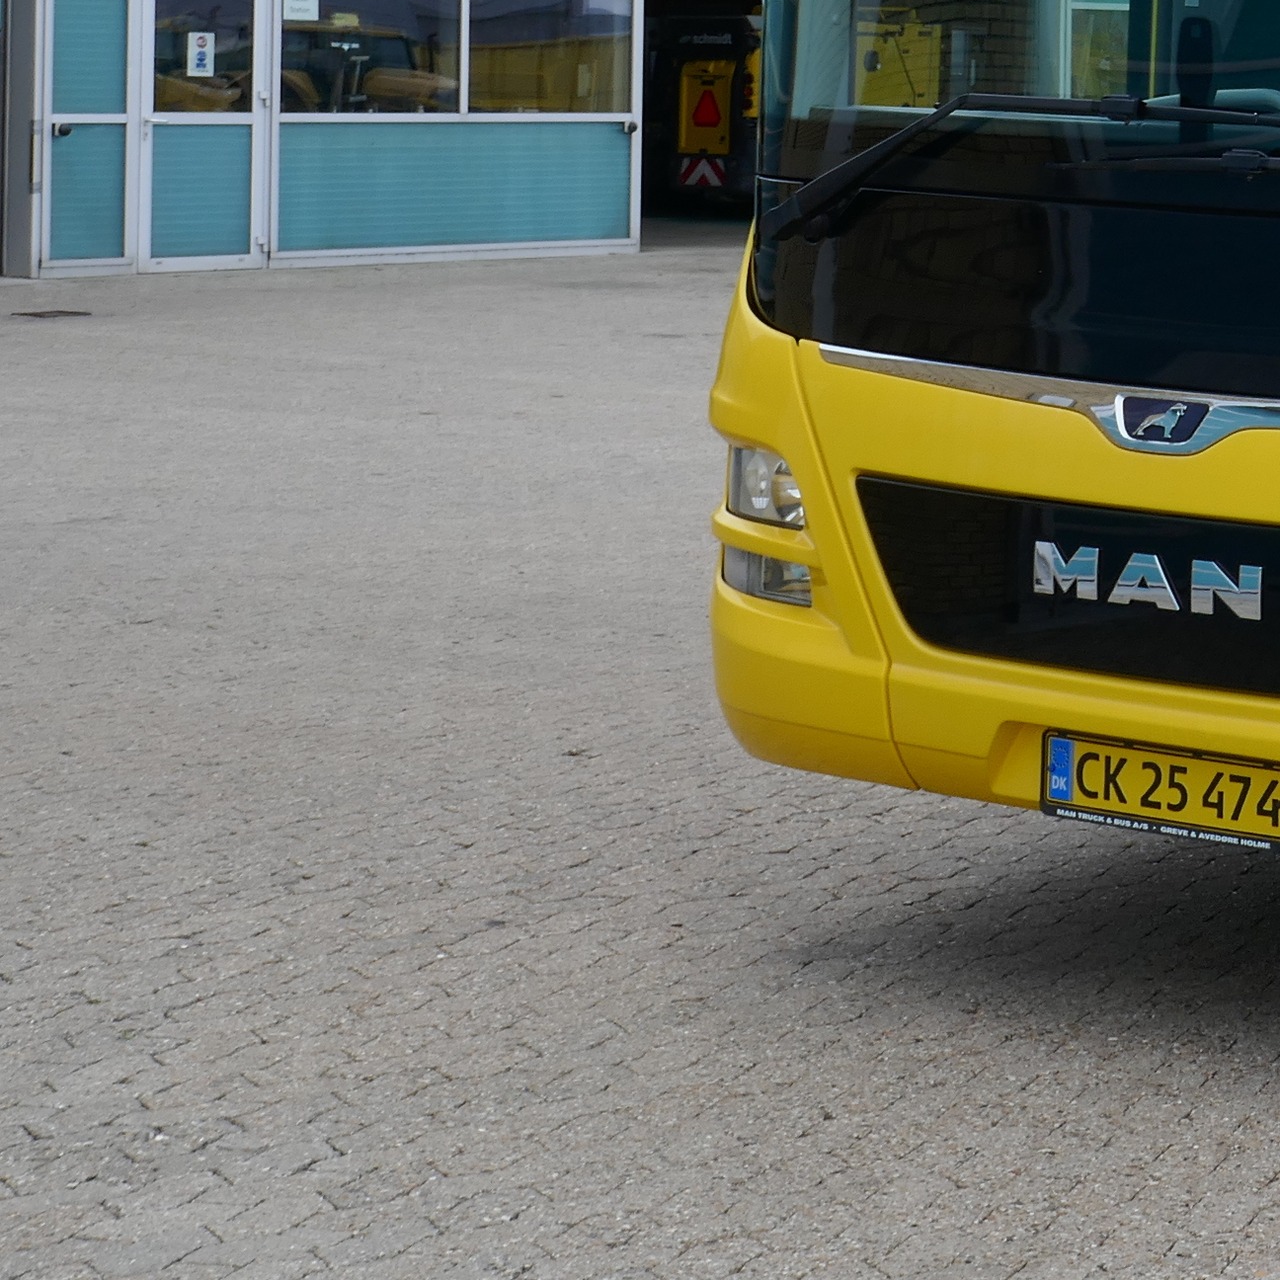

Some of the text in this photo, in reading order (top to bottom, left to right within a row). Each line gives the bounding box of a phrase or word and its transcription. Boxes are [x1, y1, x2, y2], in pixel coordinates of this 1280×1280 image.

[1033, 540, 1264, 621] MAN
[1051, 775, 1067, 791] DK
[1076, 751, 1280, 827] CK 25 474
[1056, 808, 1076, 819] MAN
[1078, 812, 1105, 823] TRUCK
[1113, 818, 1132, 827] BUS
[1132, 821, 1149, 830] A/S
[1160, 825, 1189, 837] GREVE
[1190, 830, 1197, 838] &
[1198, 831, 1239, 845] AVEDØRE
[1240, 838, 1271, 849] HOLME
